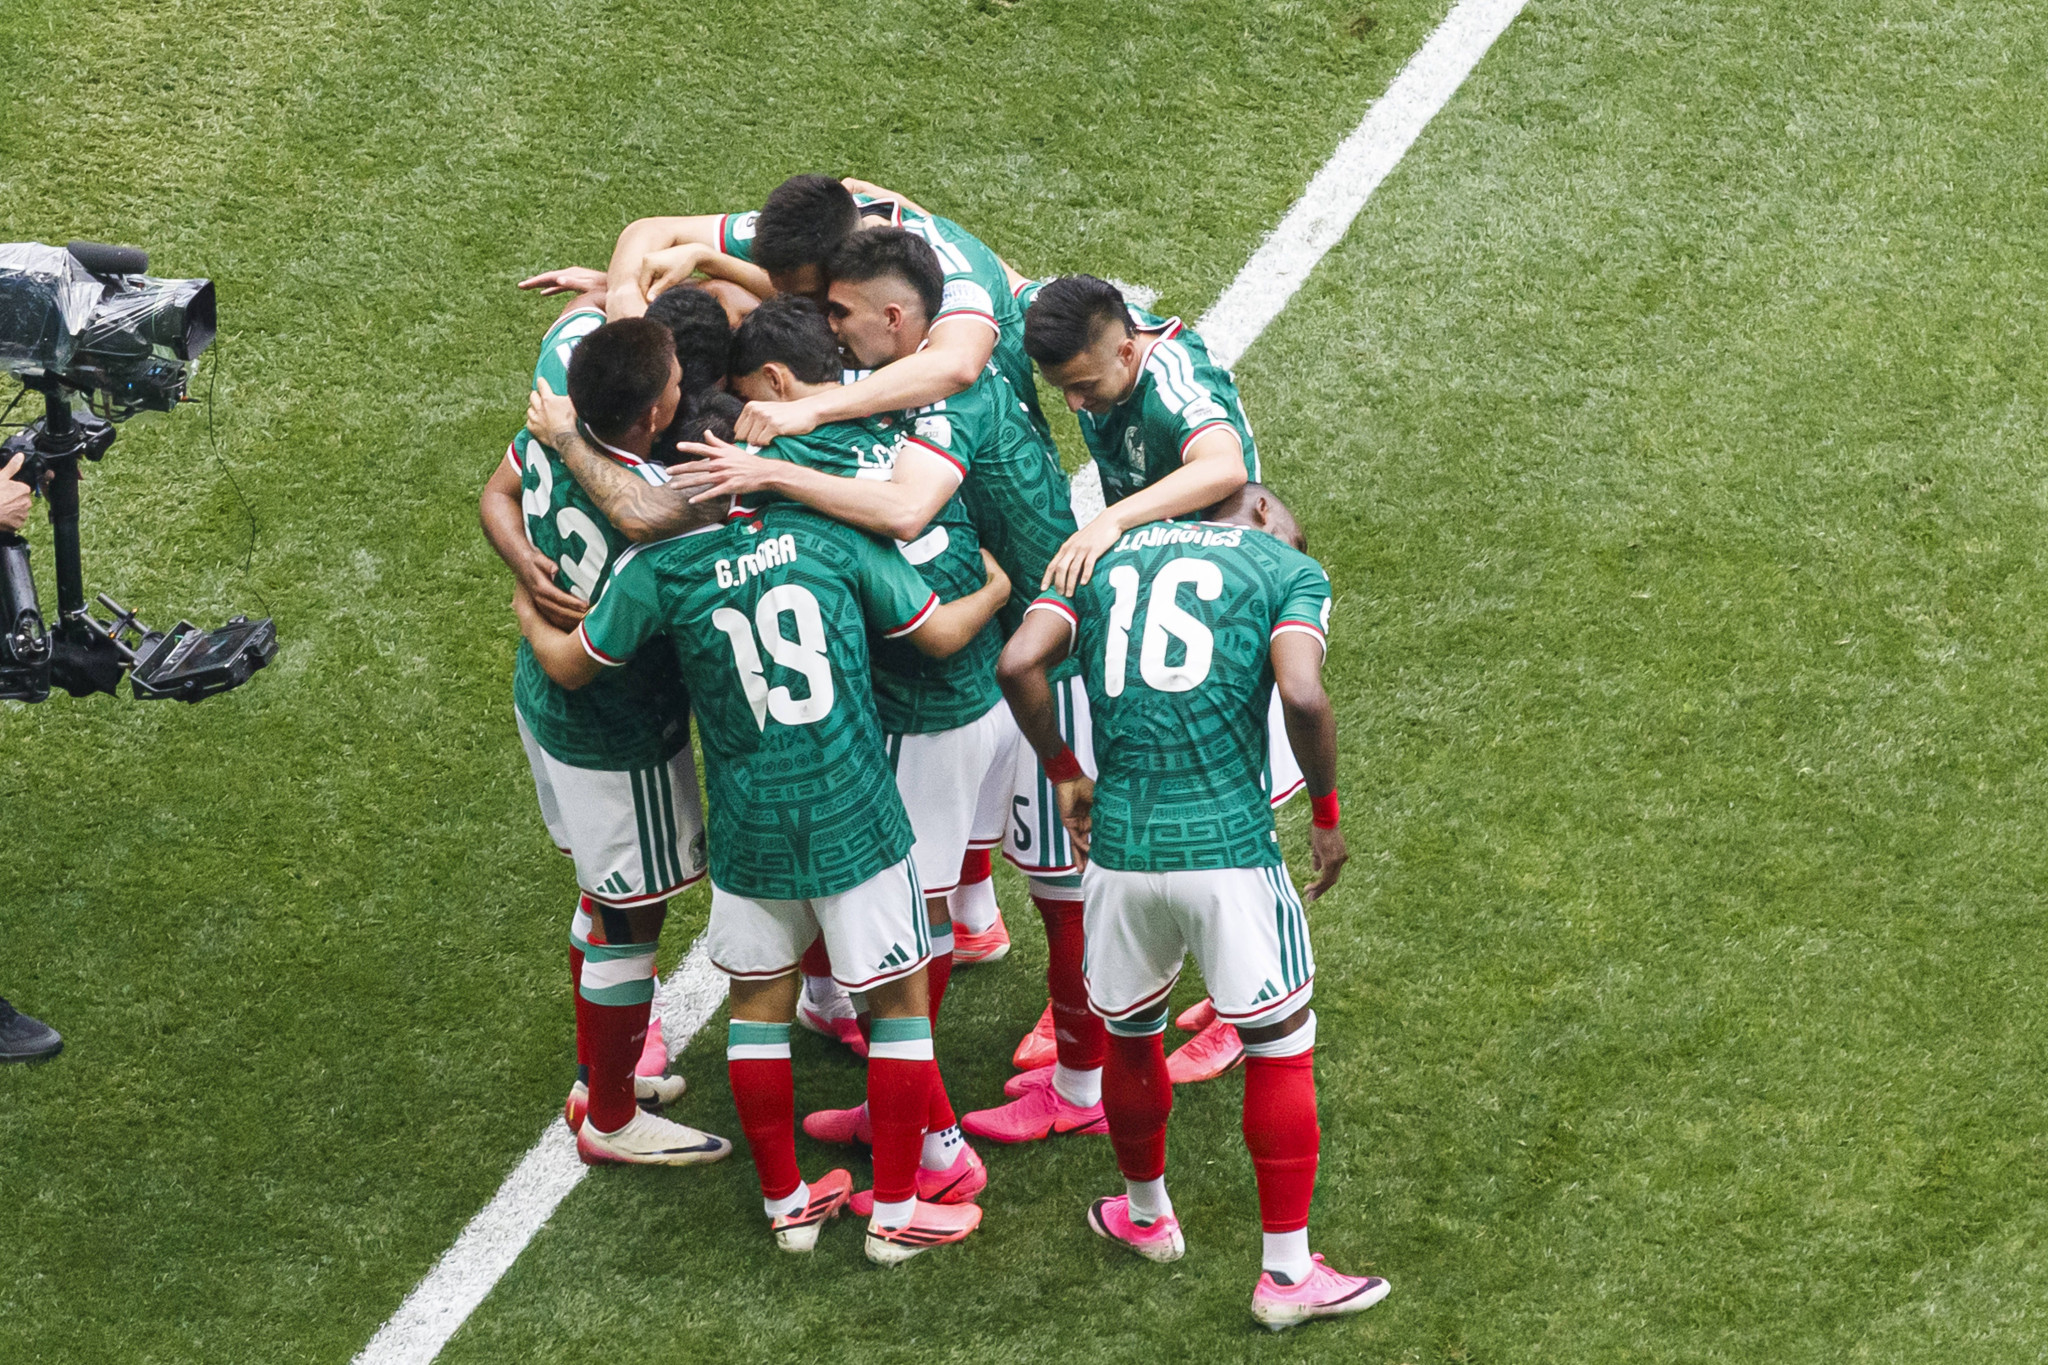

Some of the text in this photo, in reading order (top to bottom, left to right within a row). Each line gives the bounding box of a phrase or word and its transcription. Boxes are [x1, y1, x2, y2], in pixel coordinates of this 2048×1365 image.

[715, 534, 797, 589] G.MORA
[1104, 557, 1224, 698] 16
[712, 584, 835, 733] 19
